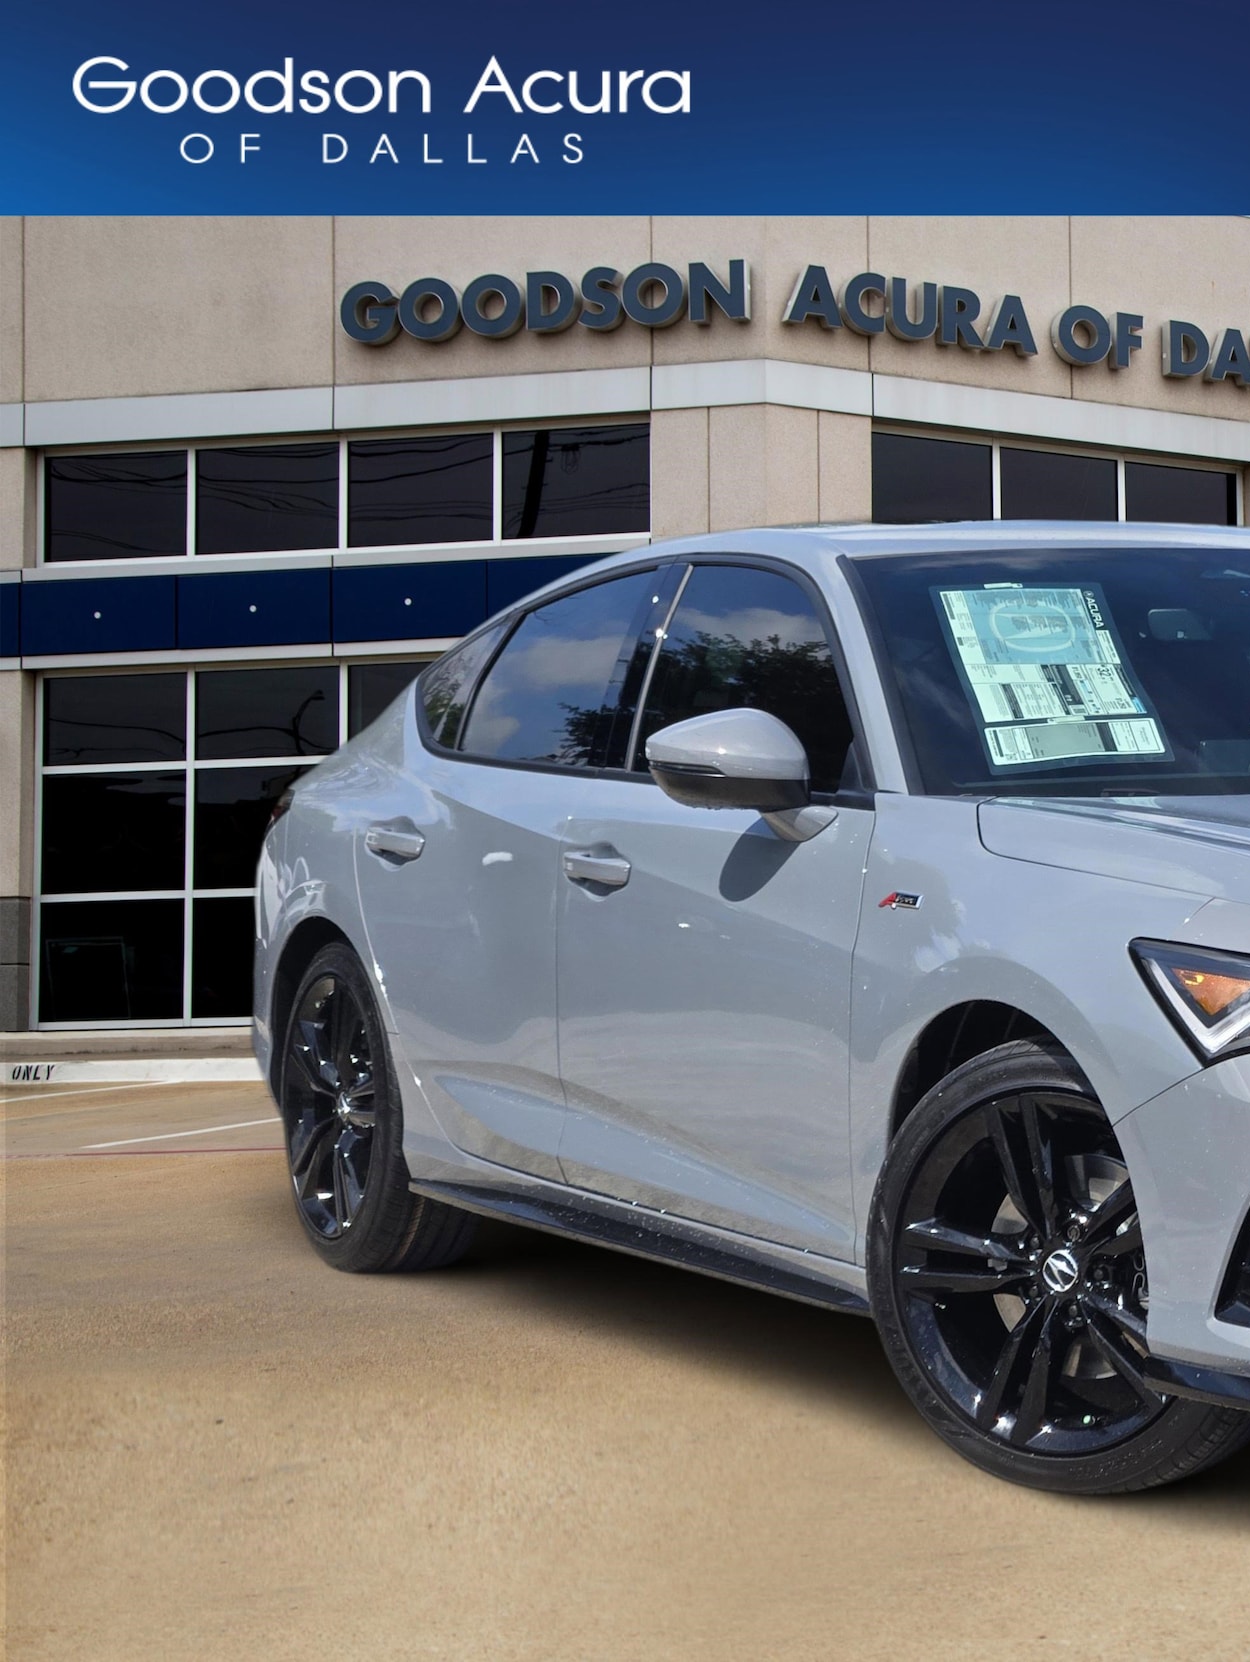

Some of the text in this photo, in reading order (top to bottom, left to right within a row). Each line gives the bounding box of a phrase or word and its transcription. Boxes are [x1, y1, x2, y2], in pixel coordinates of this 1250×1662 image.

[340, 259, 750, 346] GOODSON
[783, 265, 1038, 357] ACURA
[1051, 304, 1144, 370] OF
[1085, 597, 1104, 628] ACURA
[12, 1064, 55, 1081] ONLY
